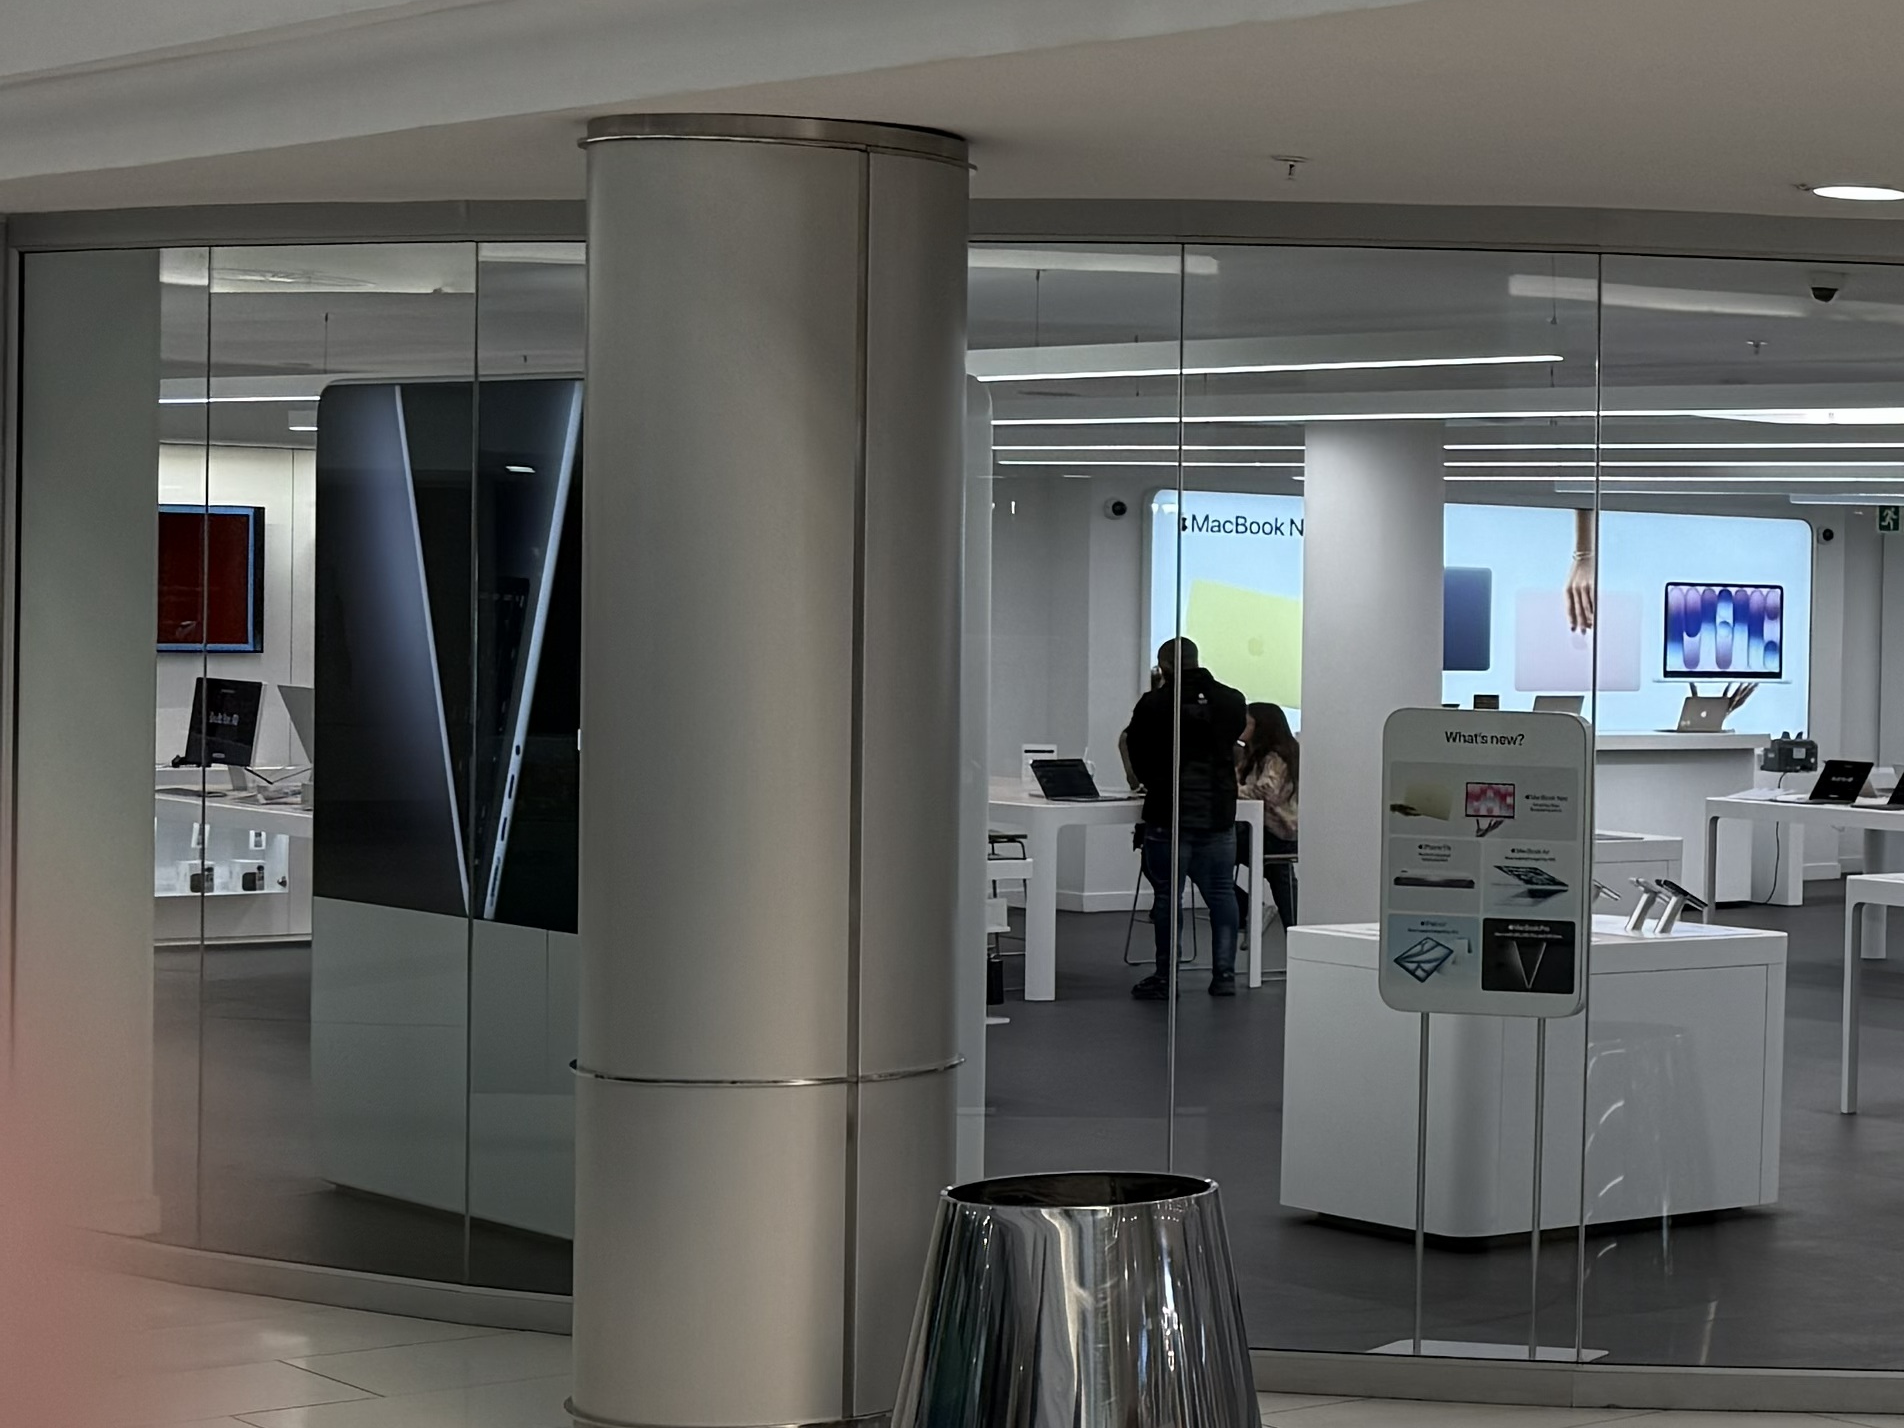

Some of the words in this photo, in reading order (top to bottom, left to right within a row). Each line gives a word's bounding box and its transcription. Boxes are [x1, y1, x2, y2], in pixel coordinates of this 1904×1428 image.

[1191, 514, 1285, 537] MacBook
[1445, 731, 1488, 745] What's
[1490, 733, 1525, 746] new?
